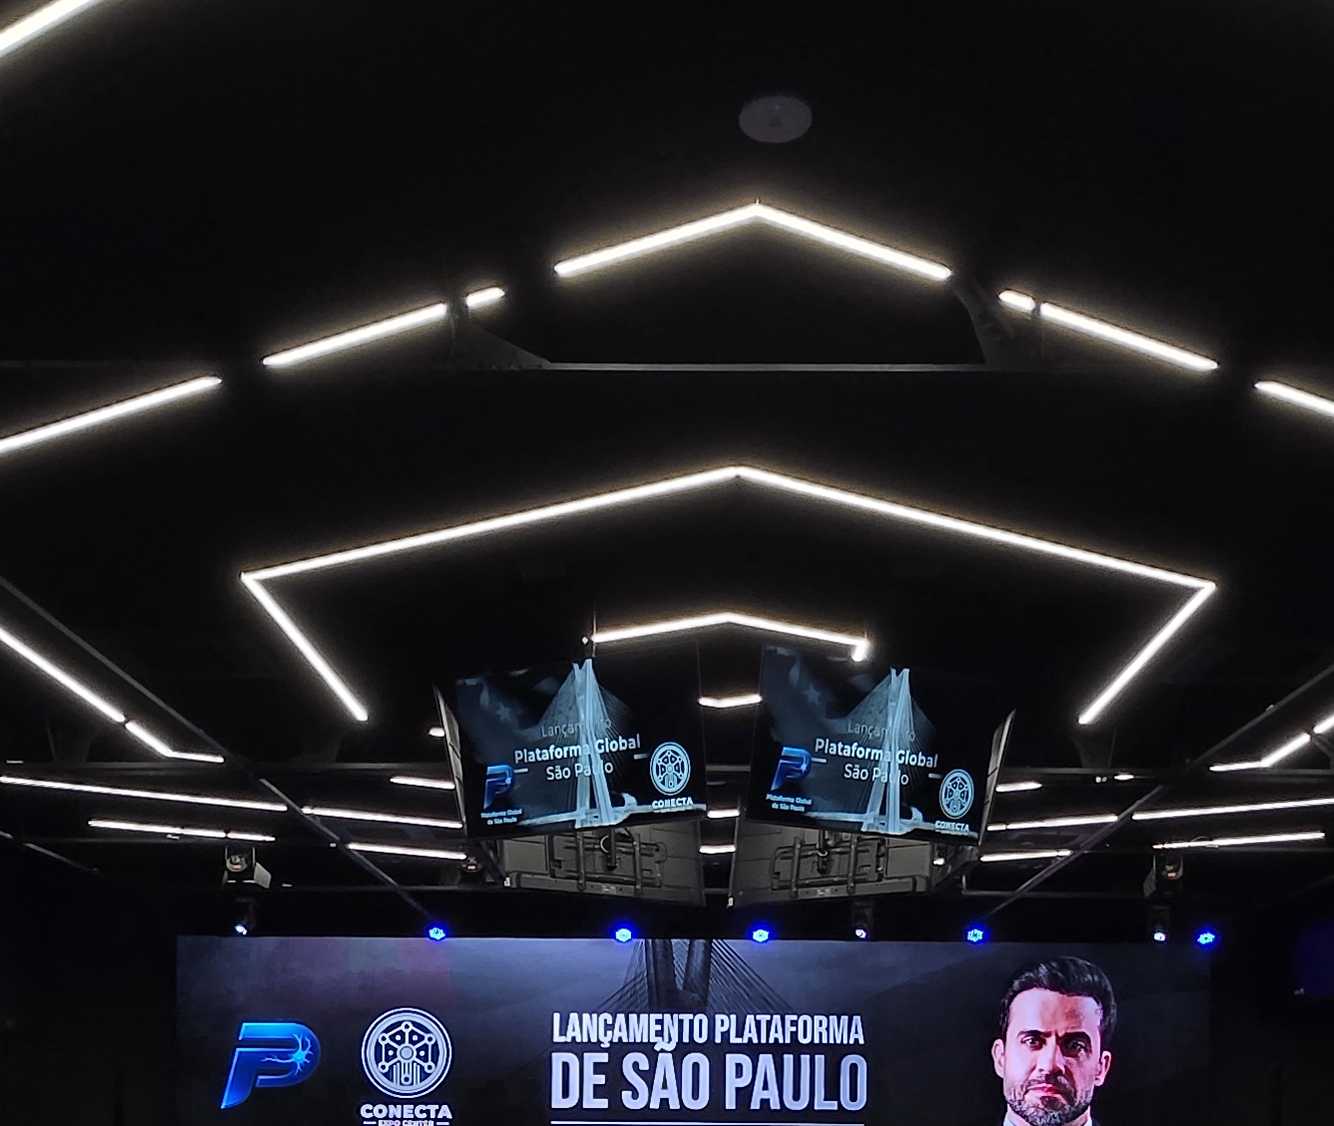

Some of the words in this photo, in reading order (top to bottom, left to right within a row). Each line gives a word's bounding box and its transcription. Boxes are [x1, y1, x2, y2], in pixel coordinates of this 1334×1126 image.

[541, 718, 612, 738] Lançamto
[848, 721, 916, 742] Lançamo
[514, 744, 590, 764] Plataforma
[595, 733, 641, 755] Global
[815, 738, 891, 762] Plataforma
[896, 749, 938, 768] Global
[546, 765, 571, 781] São
[844, 763, 869, 781] São
[552, 1012, 709, 1048] LANÇAMENTO
[714, 1014, 865, 1045] PLATAFORMA
[551, 1051, 610, 1110] DE
[620, 1039, 711, 1111] SÃO
[725, 1053, 868, 1112] PAULO
[360, 1103, 453, 1119] CONECTA
